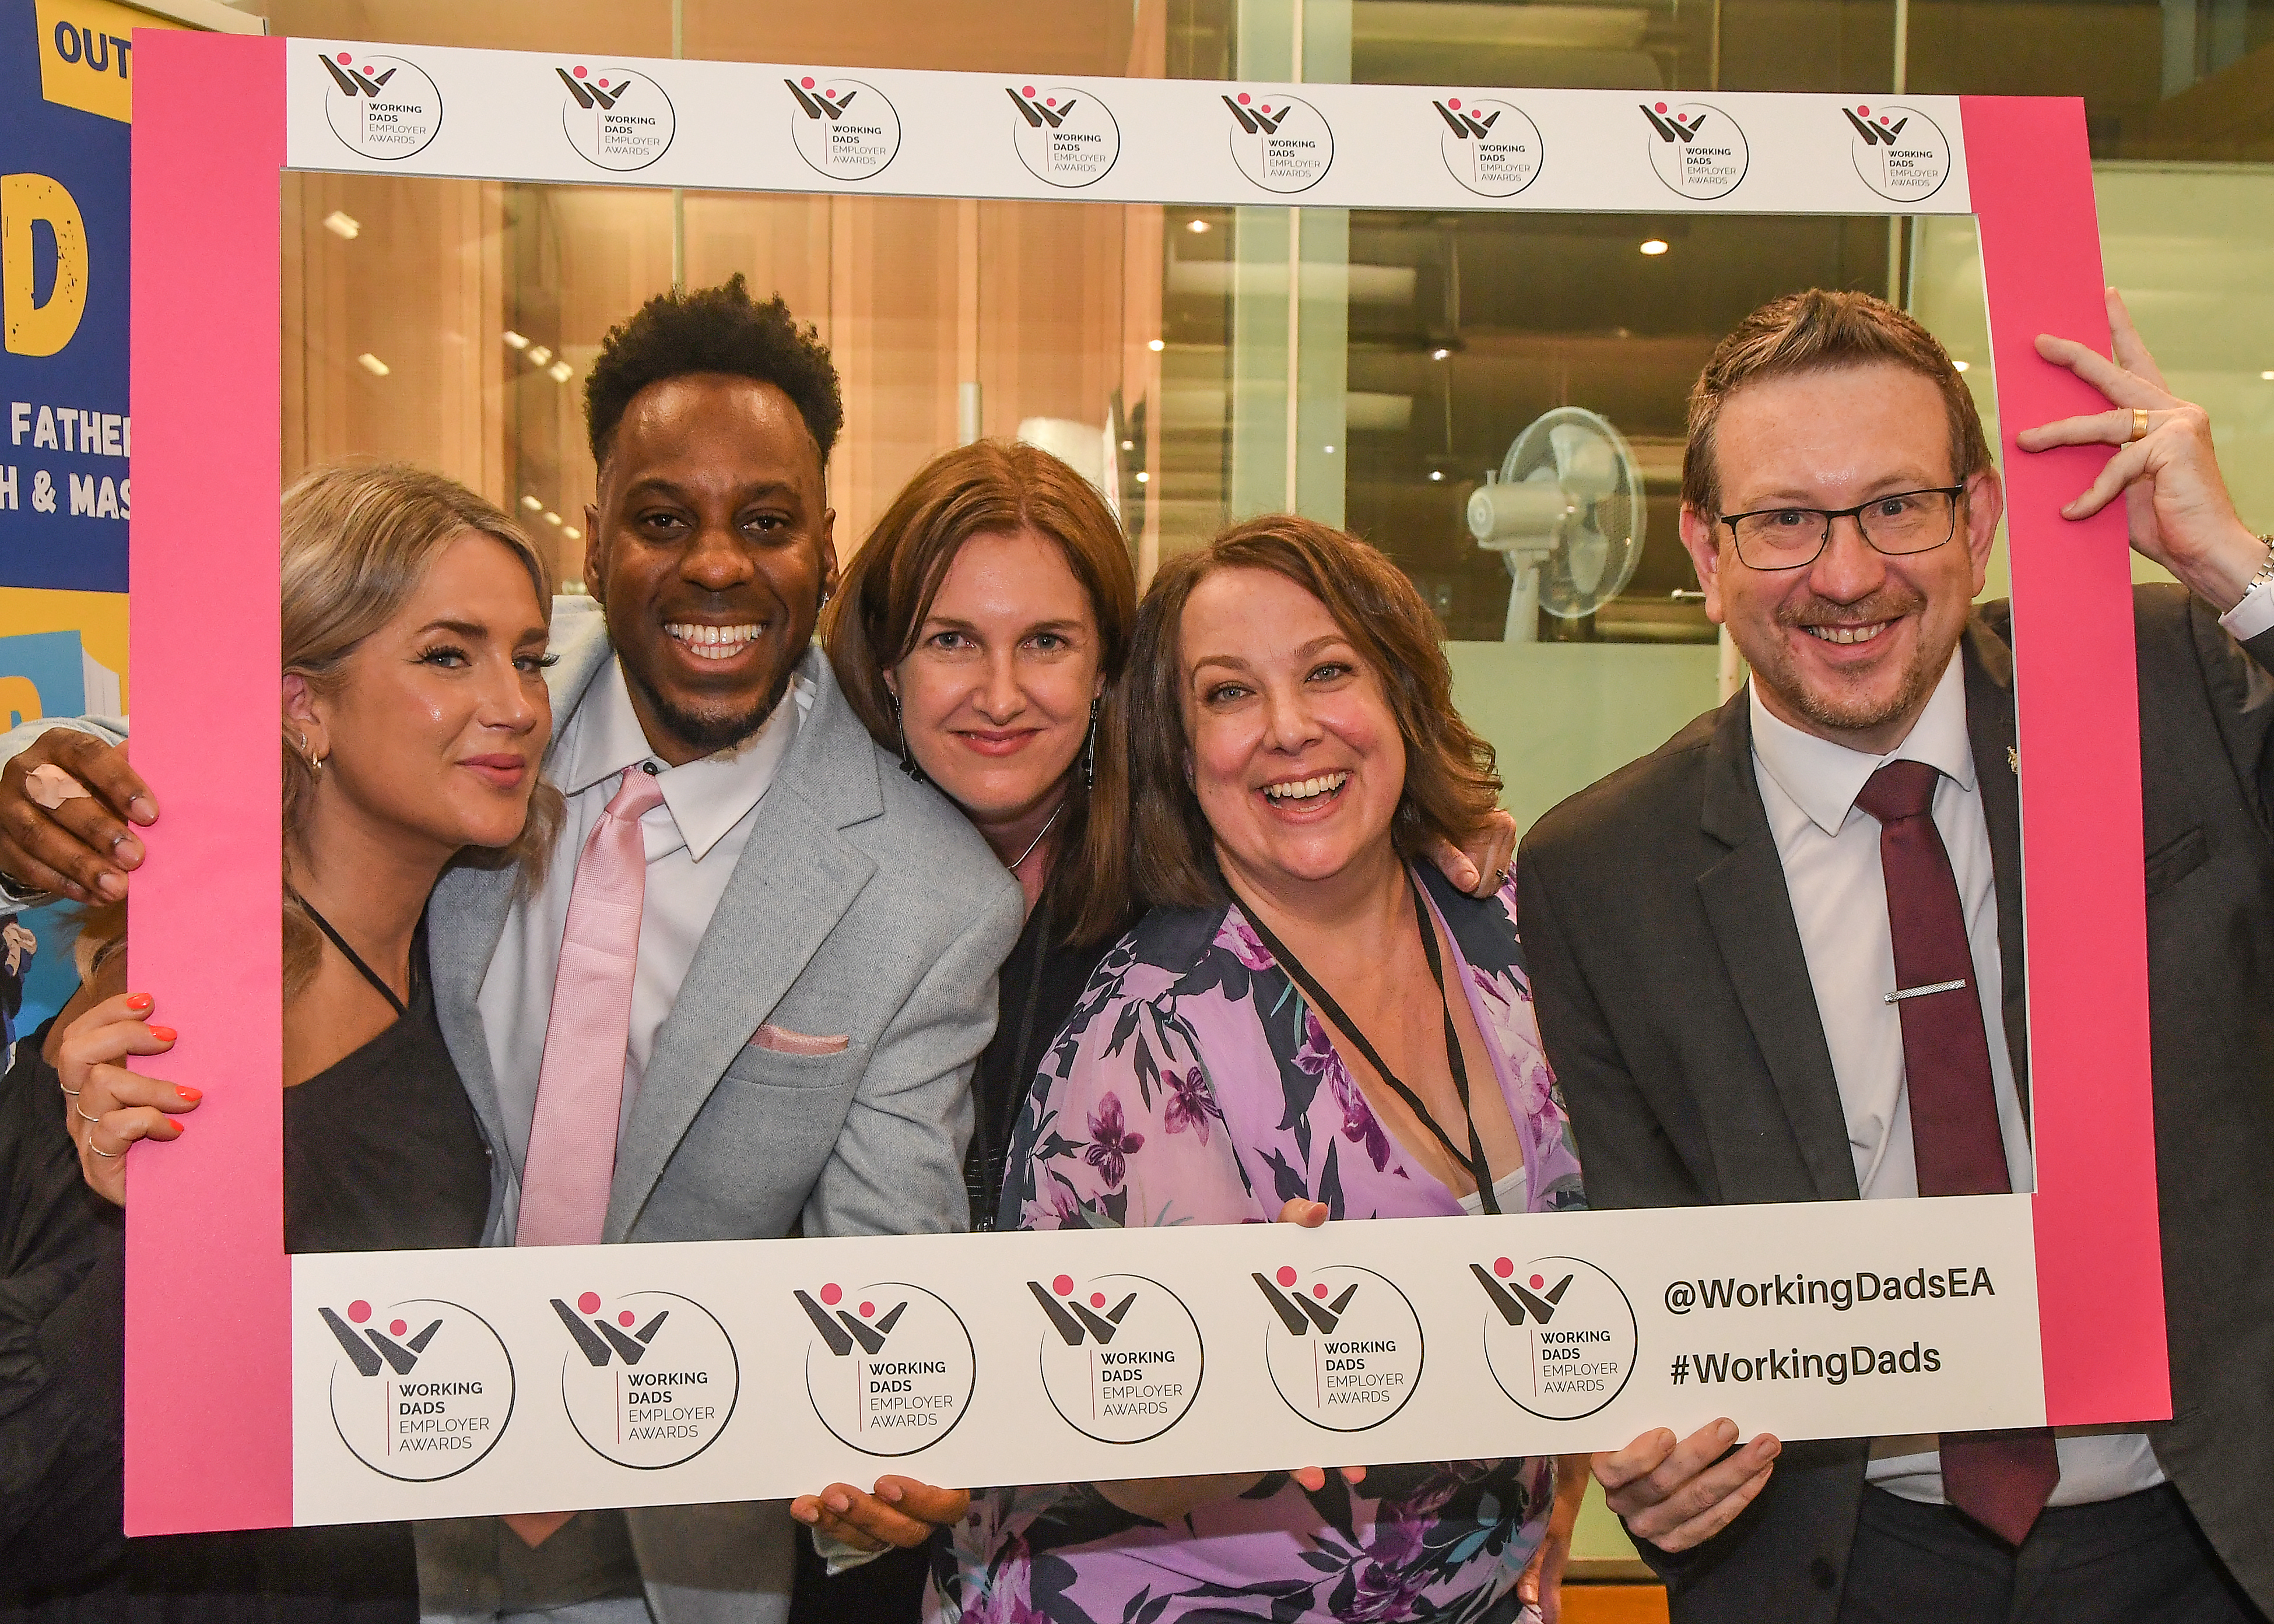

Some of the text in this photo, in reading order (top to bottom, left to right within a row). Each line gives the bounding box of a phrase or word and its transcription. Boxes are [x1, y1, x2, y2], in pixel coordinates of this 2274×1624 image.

[369, 103, 422, 114] WORKING
[369, 113, 398, 122] DADS
[604, 115, 656, 125] WORKING
[369, 123, 426, 135] EMPLOYER
[605, 125, 633, 135] DADS
[831, 125, 882, 135] WORKING
[369, 134, 415, 145] AWARDS
[605, 135, 660, 146] EMPLOYER
[832, 135, 860, 144] DADS
[1052, 133, 1101, 143] WORKING
[1054, 143, 1080, 152] DADS
[1268, 139, 1316, 149] WORKING
[1479, 144, 1525, 153] WORKING
[605, 146, 650, 156] AWARDS
[833, 145, 886, 155] EMPLOYER
[1269, 149, 1295, 157] DADS
[1685, 147, 1731, 156] WORKING
[1887, 150, 1933, 159] WORKING
[833, 156, 876, 165] AWARDS
[1054, 153, 1106, 163] EMPLOYER
[1480, 153, 1506, 162] DADS
[1686, 157, 1712, 165] DADS
[1054, 163, 1097, 172] AWARDS
[1269, 159, 1321, 168] EMPLOYER
[1480, 163, 1531, 173] EMPLOYER
[1270, 169, 1311, 178] AWARDS
[1687, 166, 1736, 175] EMPLOYER
[1890, 169, 1938, 177] EMPLOYER
[1481, 173, 1522, 182] AWARDS
[1688, 176, 1728, 184] AWARDS
[1, 173, 89, 357] D
[32, 469, 57, 514] &
[1664, 1266, 1996, 1316] @WorkingDadsEA
[1540, 1330, 1610, 1344] WORKING
[1324, 1340, 1396, 1355] WORKING
[1100, 1351, 1175, 1365] WORKING
[1542, 1348, 1581, 1361] DADS
[868, 1361, 946, 1376] WORKING
[1325, 1358, 1365, 1372] DADS
[1669, 1340, 1942, 1386] #WorkingDads
[1543, 1362, 1618, 1377] EMPLOYER
[627, 1372, 708, 1387] WORKING
[1101, 1369, 1143, 1383] DADS
[1326, 1373, 1404, 1389] EMPLOYER
[398, 1382, 483, 1397] WORKING
[870, 1380, 912, 1394] DADS
[1103, 1383, 1182, 1400] EMPLOYER
[1544, 1379, 1605, 1394] AWARDS
[629, 1390, 672, 1405] DADS
[871, 1395, 953, 1411] EMPLOYER
[1327, 1390, 1390, 1405] AWARDS
[399, 1401, 445, 1416] DADS
[1103, 1401, 1168, 1416] AWARDS
[629, 1406, 715, 1423] EMPLOYER
[399, 1417, 489, 1434] EMPLOYER
[870, 1413, 938, 1429] AWARDS
[628, 1425, 699, 1441] AWARDS
[399, 1436, 472, 1452] AWARDS
